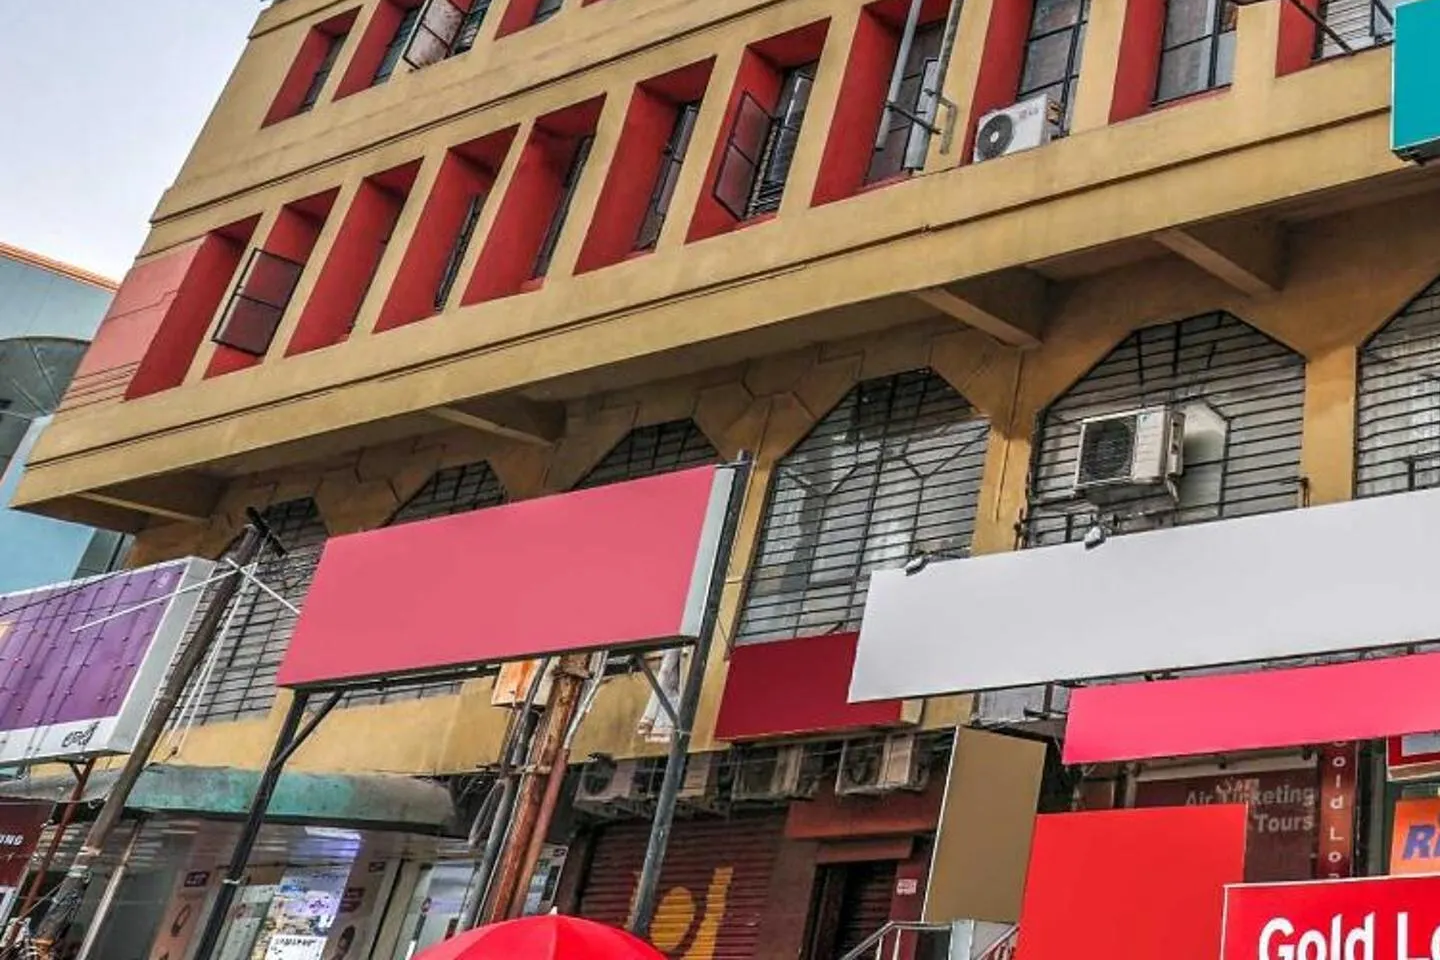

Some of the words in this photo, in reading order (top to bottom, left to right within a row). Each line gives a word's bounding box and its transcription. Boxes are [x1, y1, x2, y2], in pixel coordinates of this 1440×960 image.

[1330, 740, 1347, 810] old
[1253, 814, 1315, 834] Tours
[1258, 912, 1375, 960] Gold
